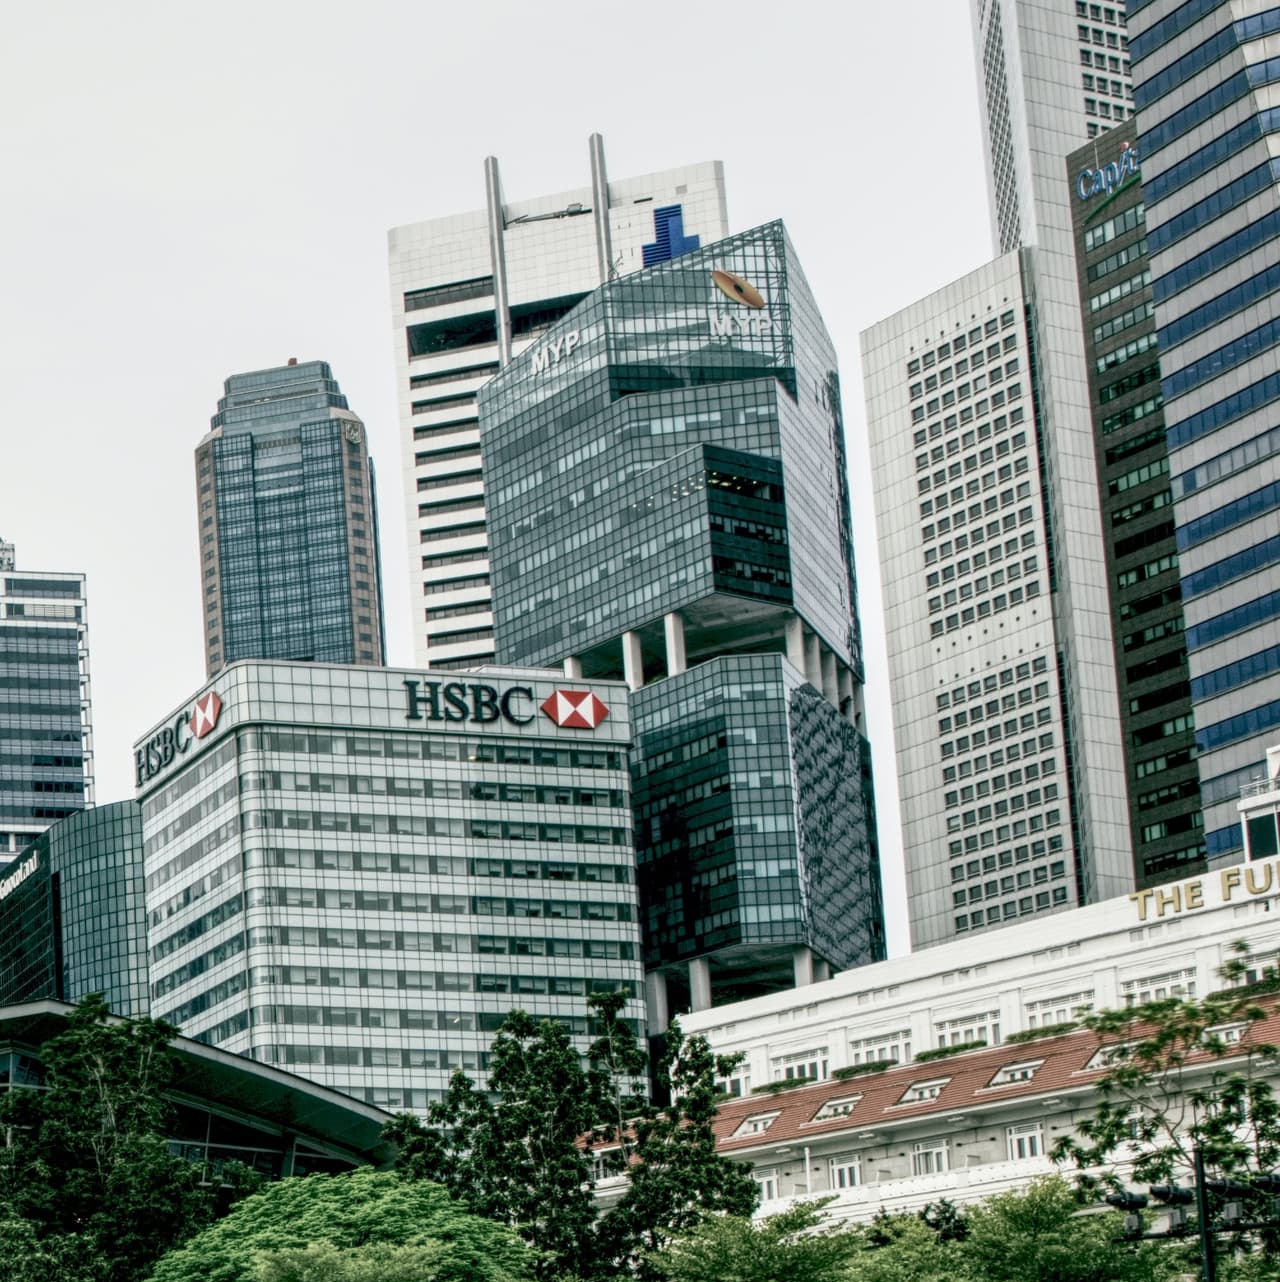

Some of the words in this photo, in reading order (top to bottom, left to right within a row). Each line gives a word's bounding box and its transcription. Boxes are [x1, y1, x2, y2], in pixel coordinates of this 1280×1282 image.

[707, 309, 773, 337] MYP
[531, 329, 580, 376] MYP
[403, 680, 535, 727] HSBC
[134, 710, 192, 787] HSBC
[1129, 880, 1205, 921] THE
